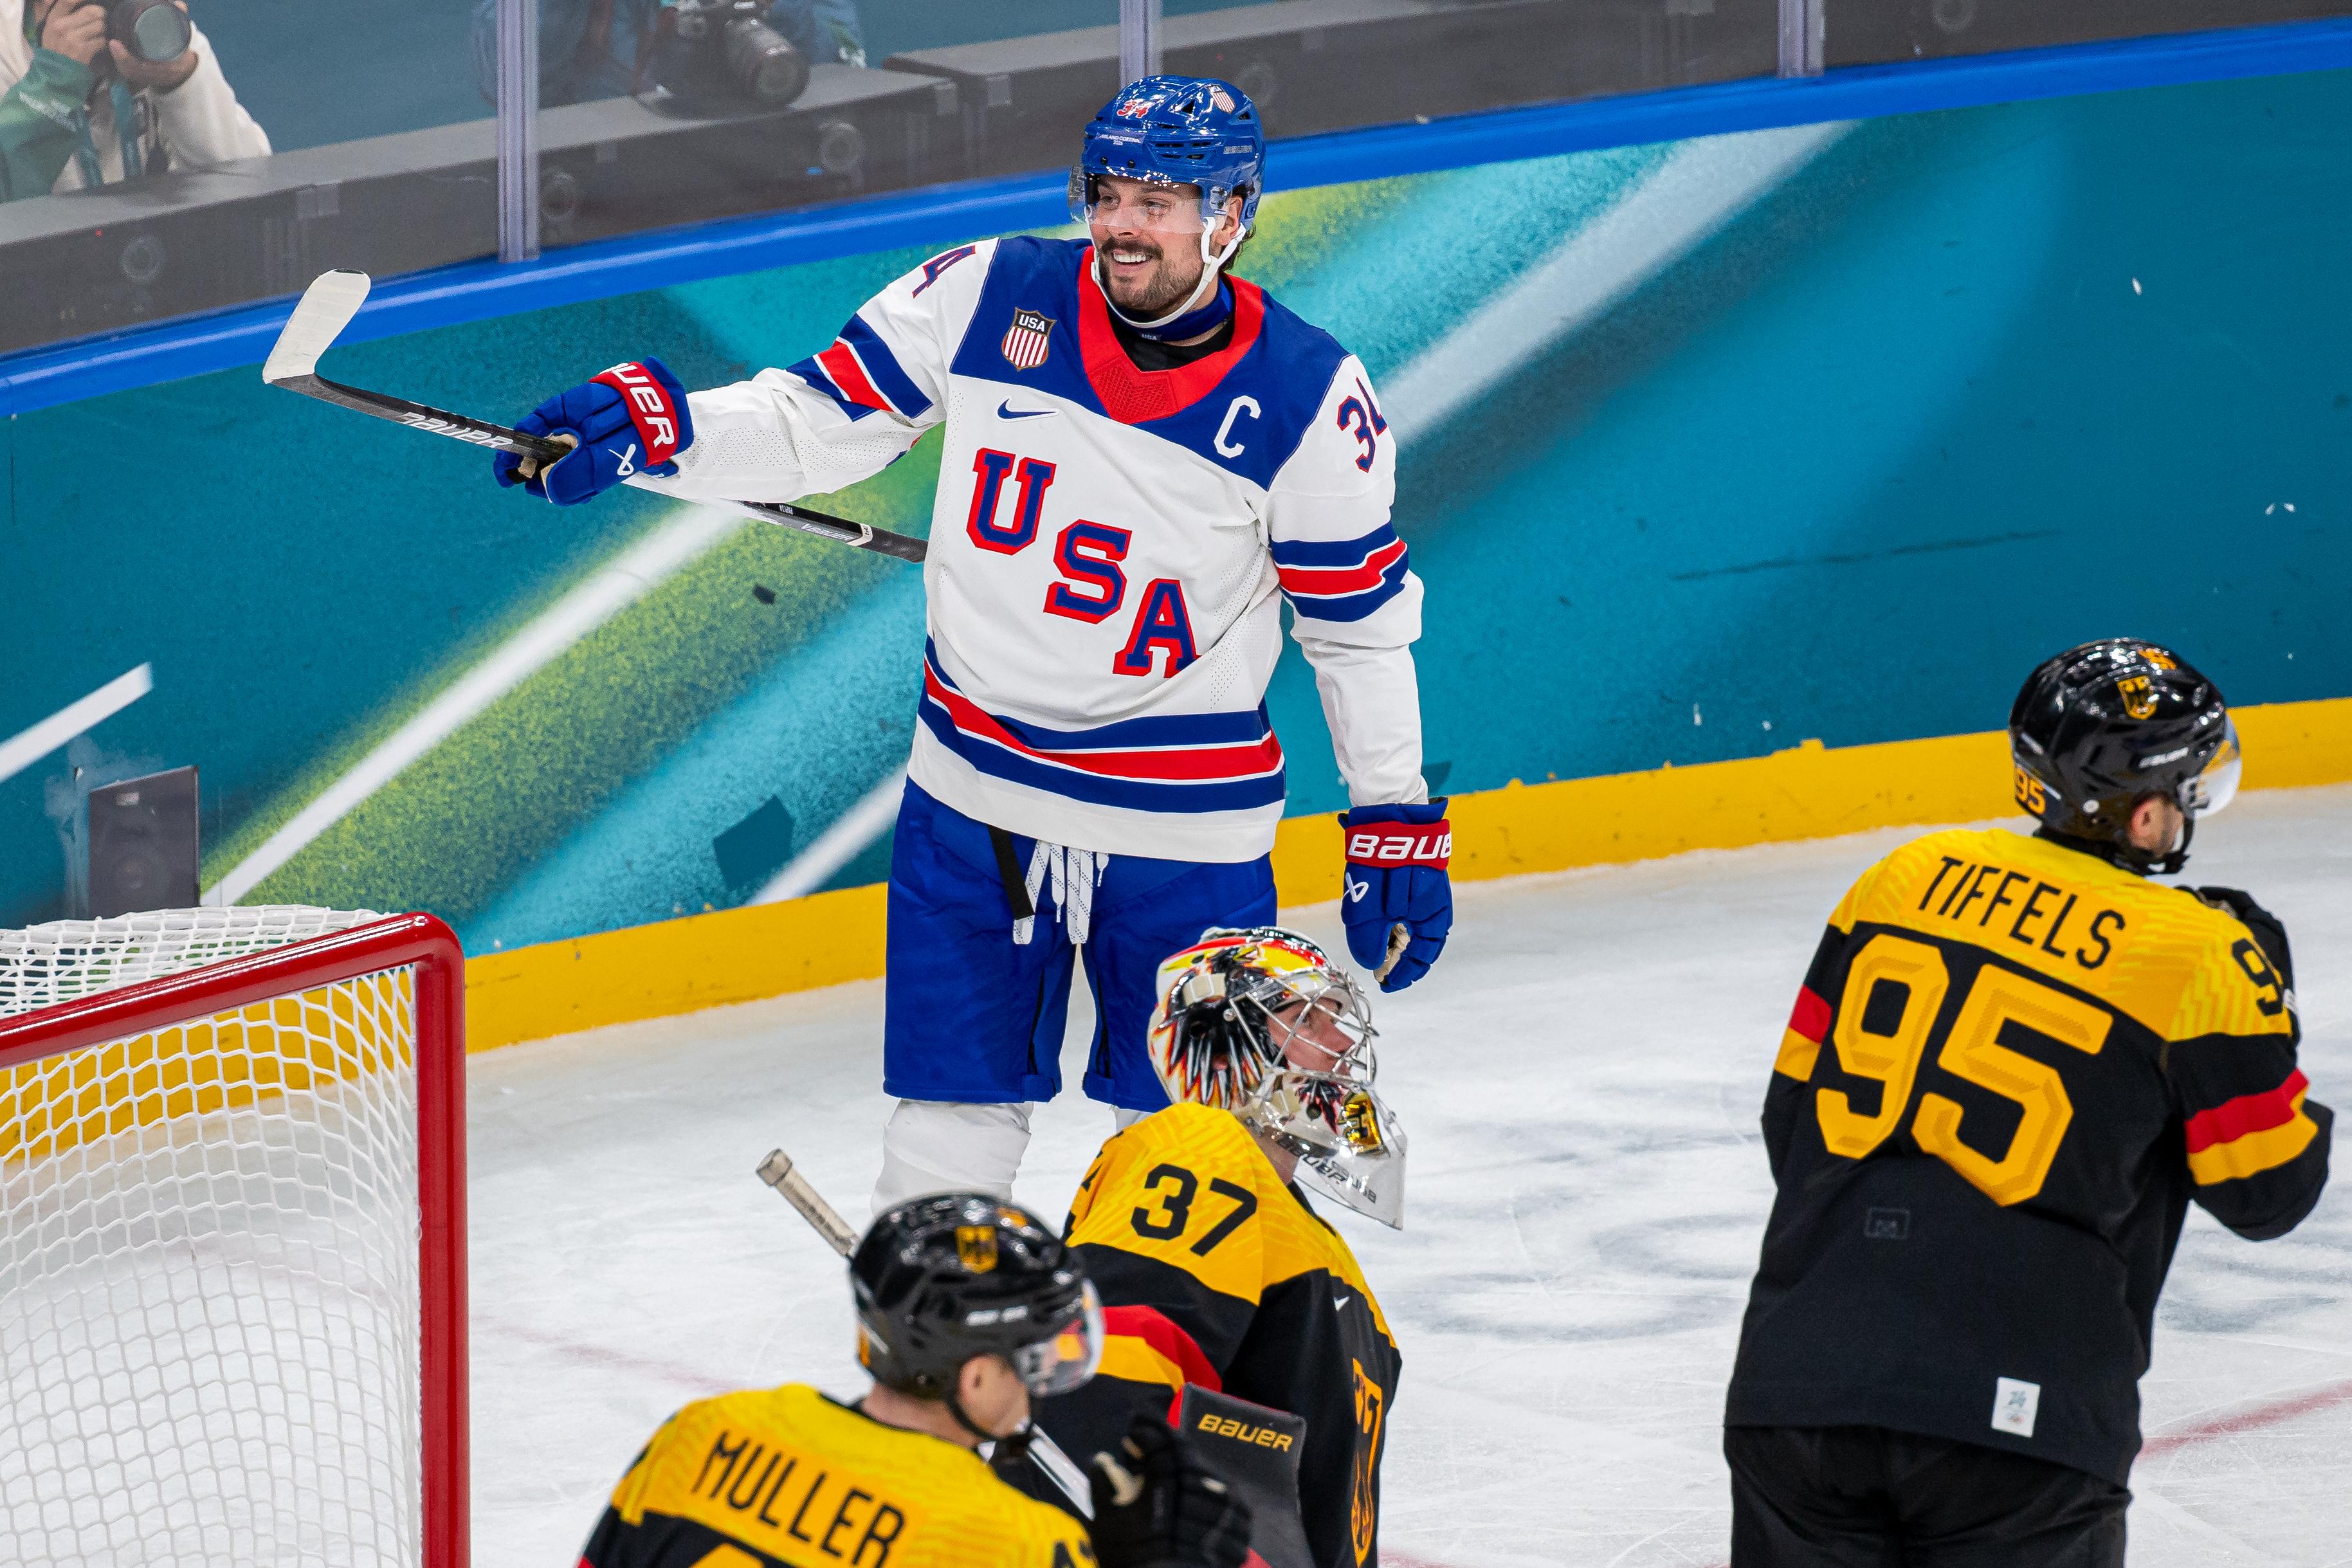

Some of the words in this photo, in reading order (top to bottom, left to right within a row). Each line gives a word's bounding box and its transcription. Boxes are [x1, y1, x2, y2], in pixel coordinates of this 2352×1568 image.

[1019, 314, 1046, 333] USA
[1214, 395, 1261, 459] C
[966, 448, 1201, 679] USA
[2016, 765, 2047, 815] 95
[1917, 855, 2126, 971] TIFFELS
[1815, 933, 2114, 1208] 95
[1131, 1163, 1257, 1258] 37
[1198, 1414, 1294, 1453] BAUER
[691, 1430, 906, 1568] MULLER
